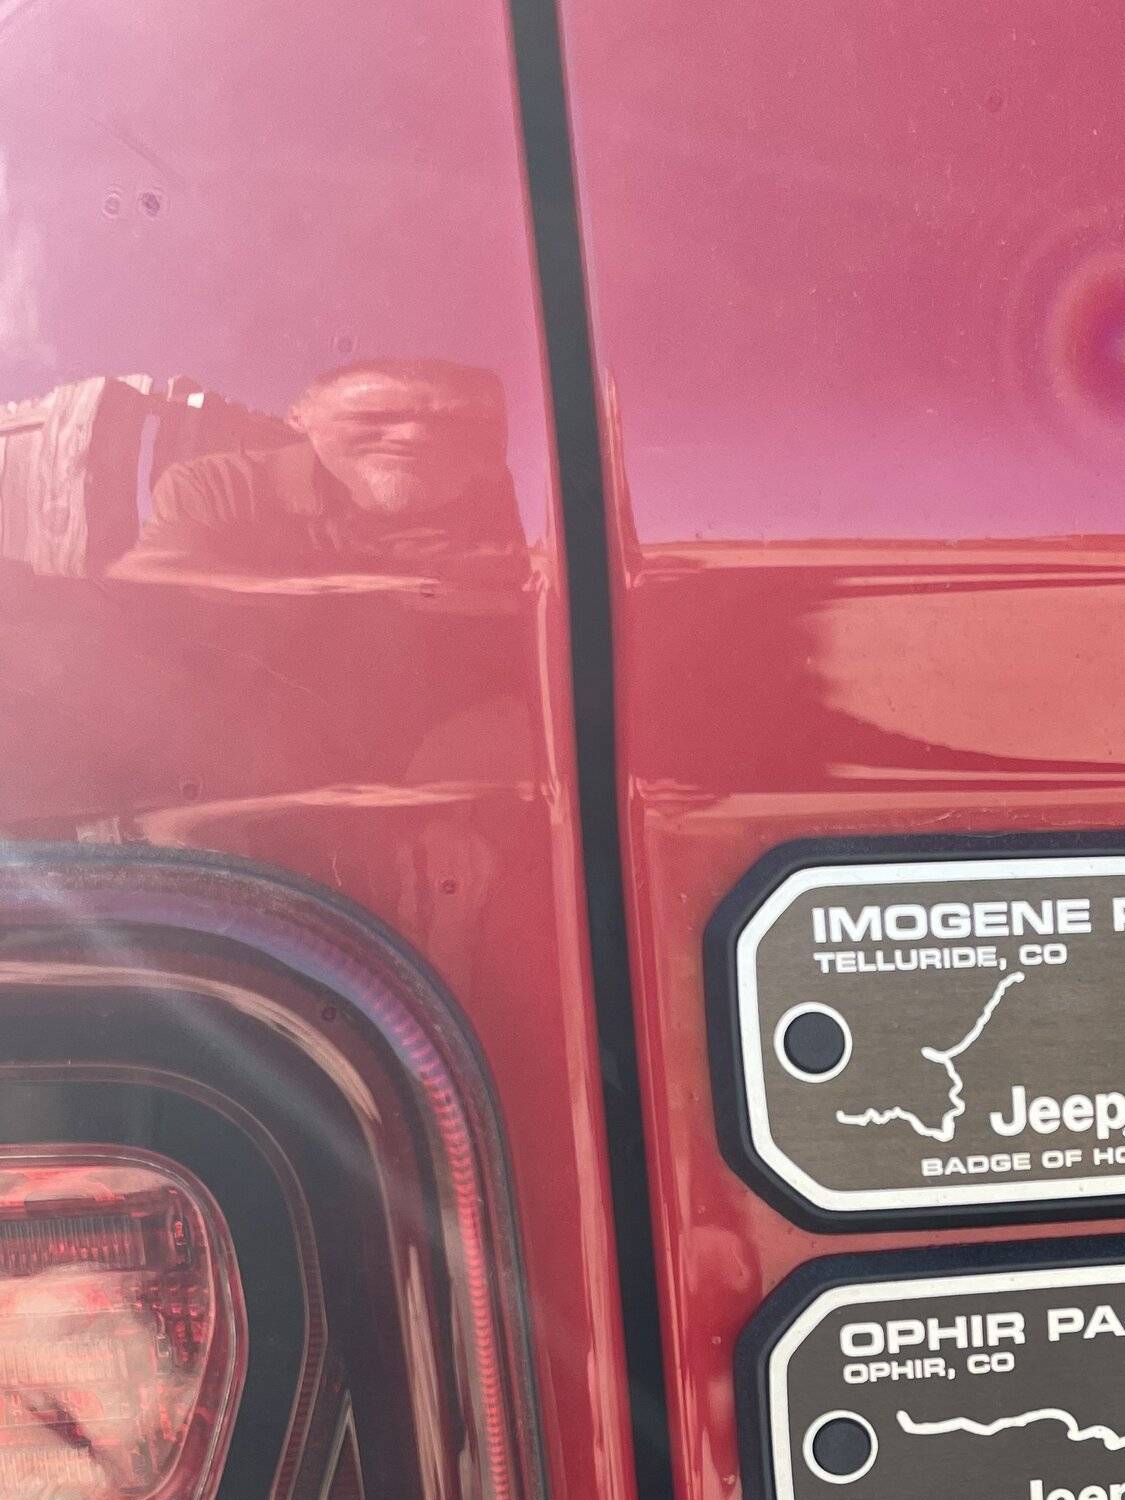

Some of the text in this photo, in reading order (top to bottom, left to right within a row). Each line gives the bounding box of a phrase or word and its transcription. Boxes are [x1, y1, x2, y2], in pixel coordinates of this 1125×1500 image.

[811, 898, 1093, 944] IMOGENE
[812, 942, 1068, 974] TELLURIDE, CO
[920, 1152, 1032, 1177] BADGE
[1041, 1148, 1083, 1169] OF
[839, 1311, 1026, 1358] OPHIR
[843, 1351, 1015, 1384] OPHIR, CO
